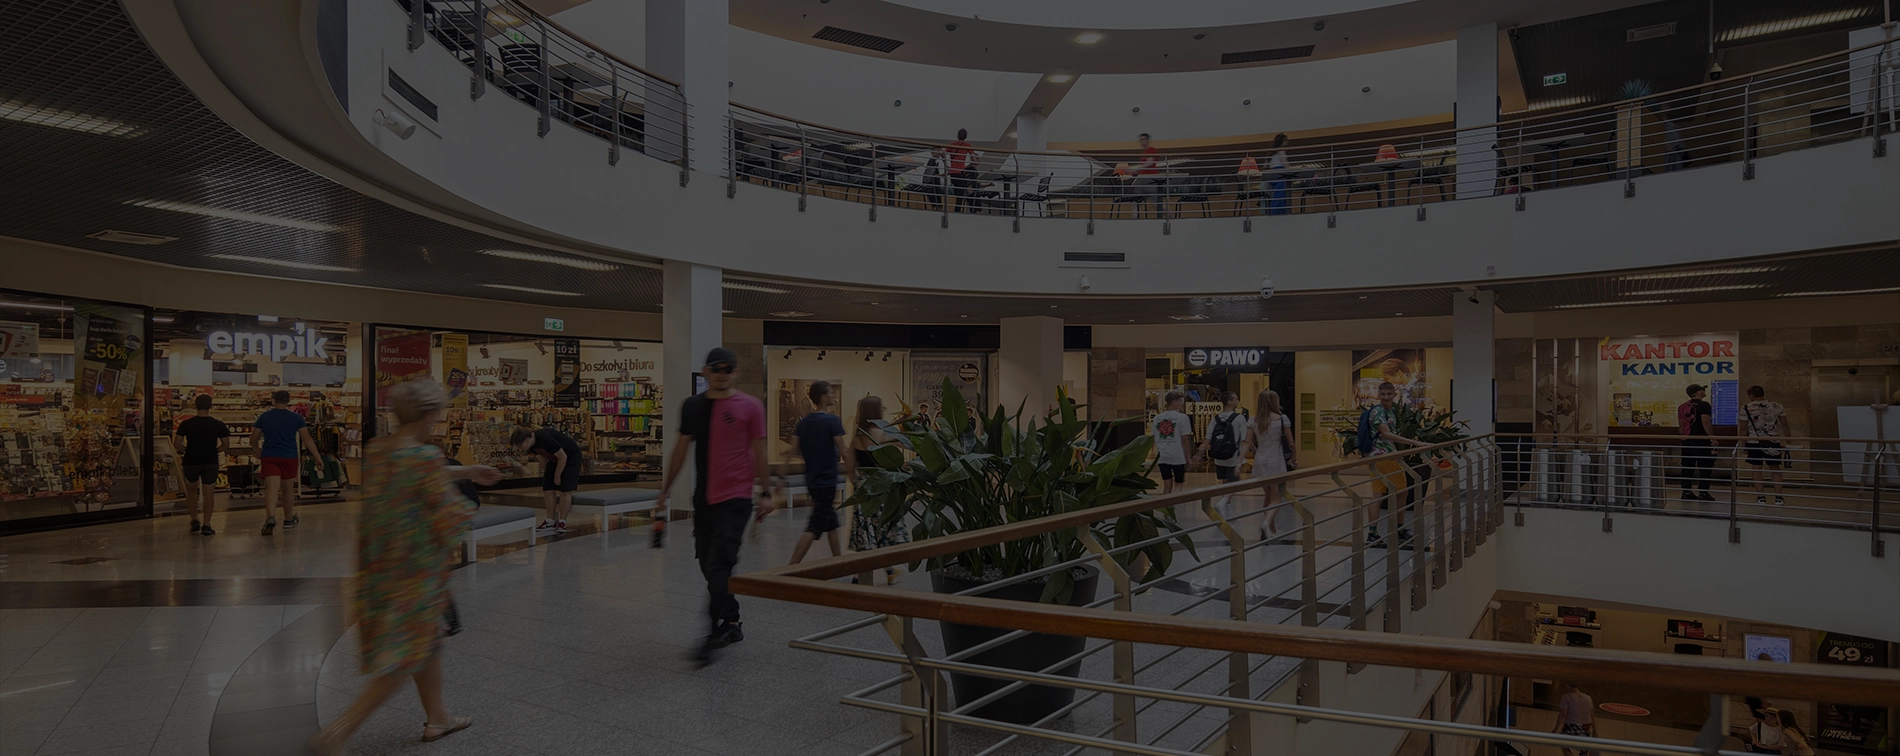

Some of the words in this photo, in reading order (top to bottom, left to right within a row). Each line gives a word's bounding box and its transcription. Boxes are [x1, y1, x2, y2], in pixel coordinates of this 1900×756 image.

[207, 322, 329, 362] empik
[90, 343, 128, 360] -50%
[380, 345, 400, 354] finał
[556, 344, 568, 354] 10
[568, 344, 578, 354] zł
[1600, 340, 1735, 361] KANTOR
[380, 356, 428, 366] wyprzedaży
[1210, 349, 1261, 366] PAWO
[580, 361, 593, 372] Do
[593, 359, 623, 374] szkoły
[629, 358, 655, 371] biura
[1621, 361, 1735, 376] KANTOR
[1198, 404, 1222, 412] PAWO
[108, 464, 139, 477] bilety
[1828, 639, 1860, 649] TRENUJ
[1828, 645, 1861, 662] 49
[1863, 654, 1875, 664] zł
[1826, 732, 1862, 741] FITNESS
[1830, 728, 1852, 736] WELL
